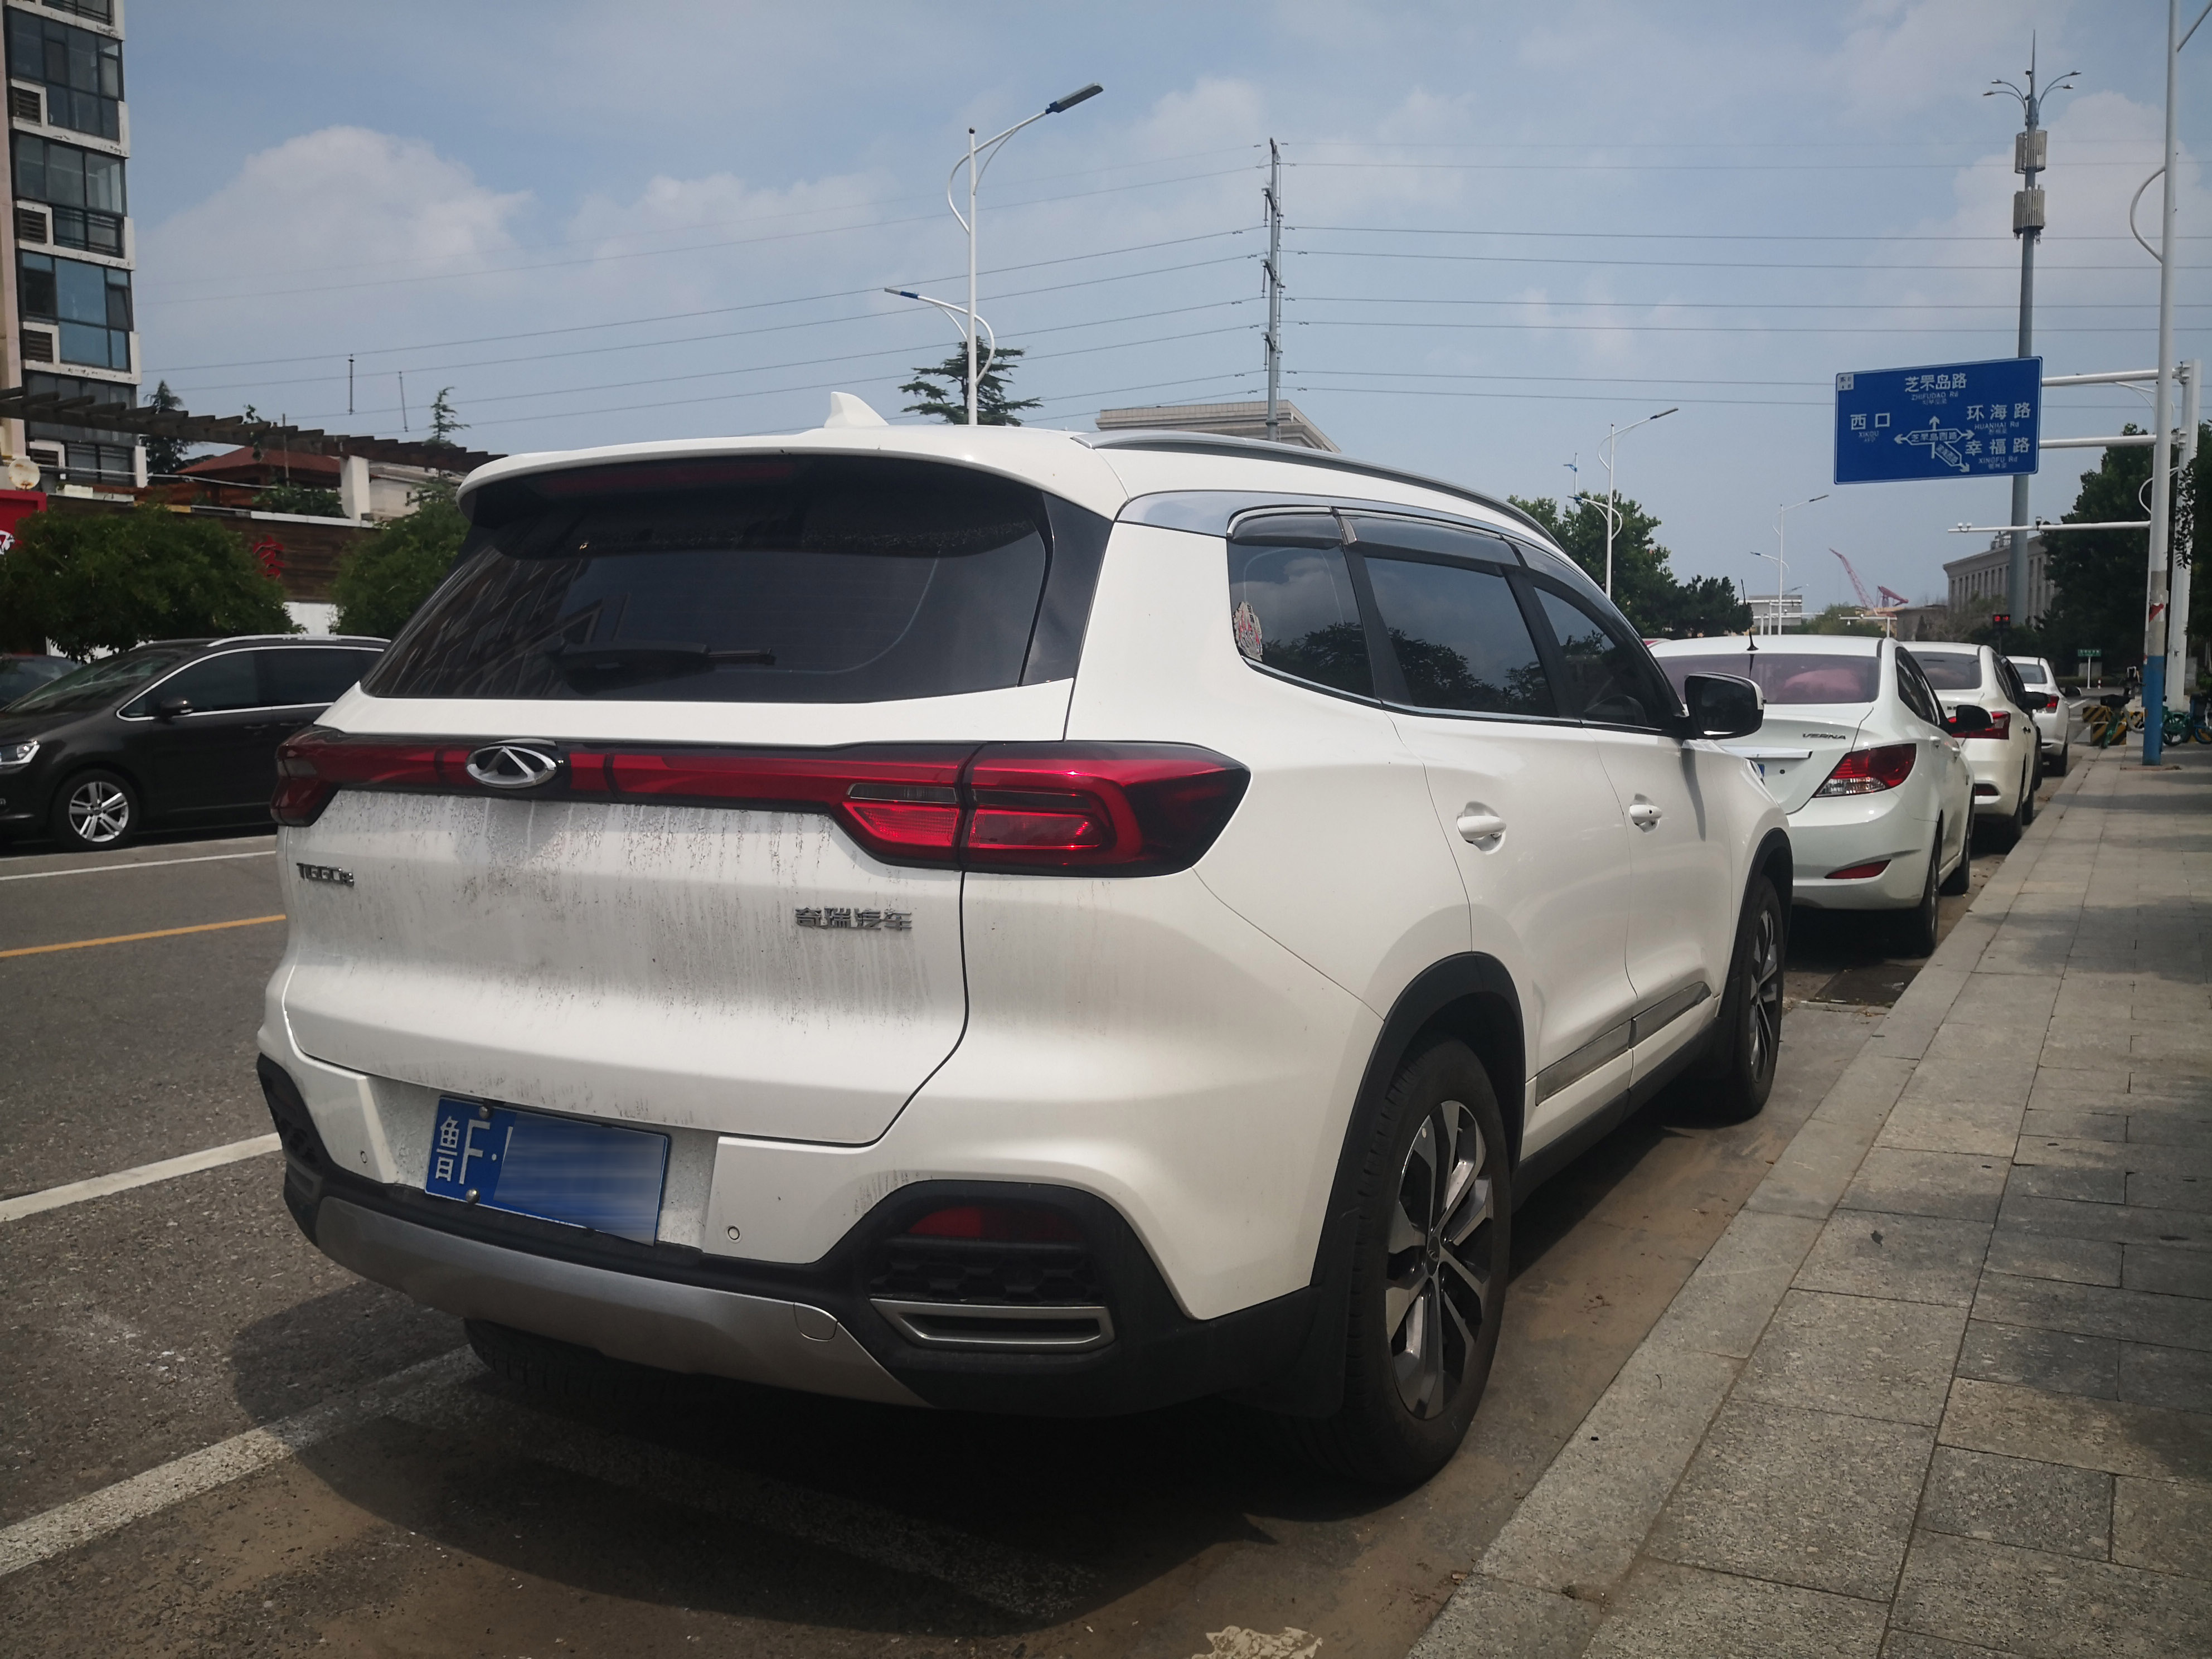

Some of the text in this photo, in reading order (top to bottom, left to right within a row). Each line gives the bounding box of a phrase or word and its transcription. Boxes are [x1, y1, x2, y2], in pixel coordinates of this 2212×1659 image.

[1905, 372, 1967, 392] 芝罘岛路
[1967, 402, 2031, 421] 环海路
[1850, 413, 1890, 430] 西口
[1965, 437, 2030, 456] 幸福路
[794, 906, 912, 931] 奇瑞汽车
